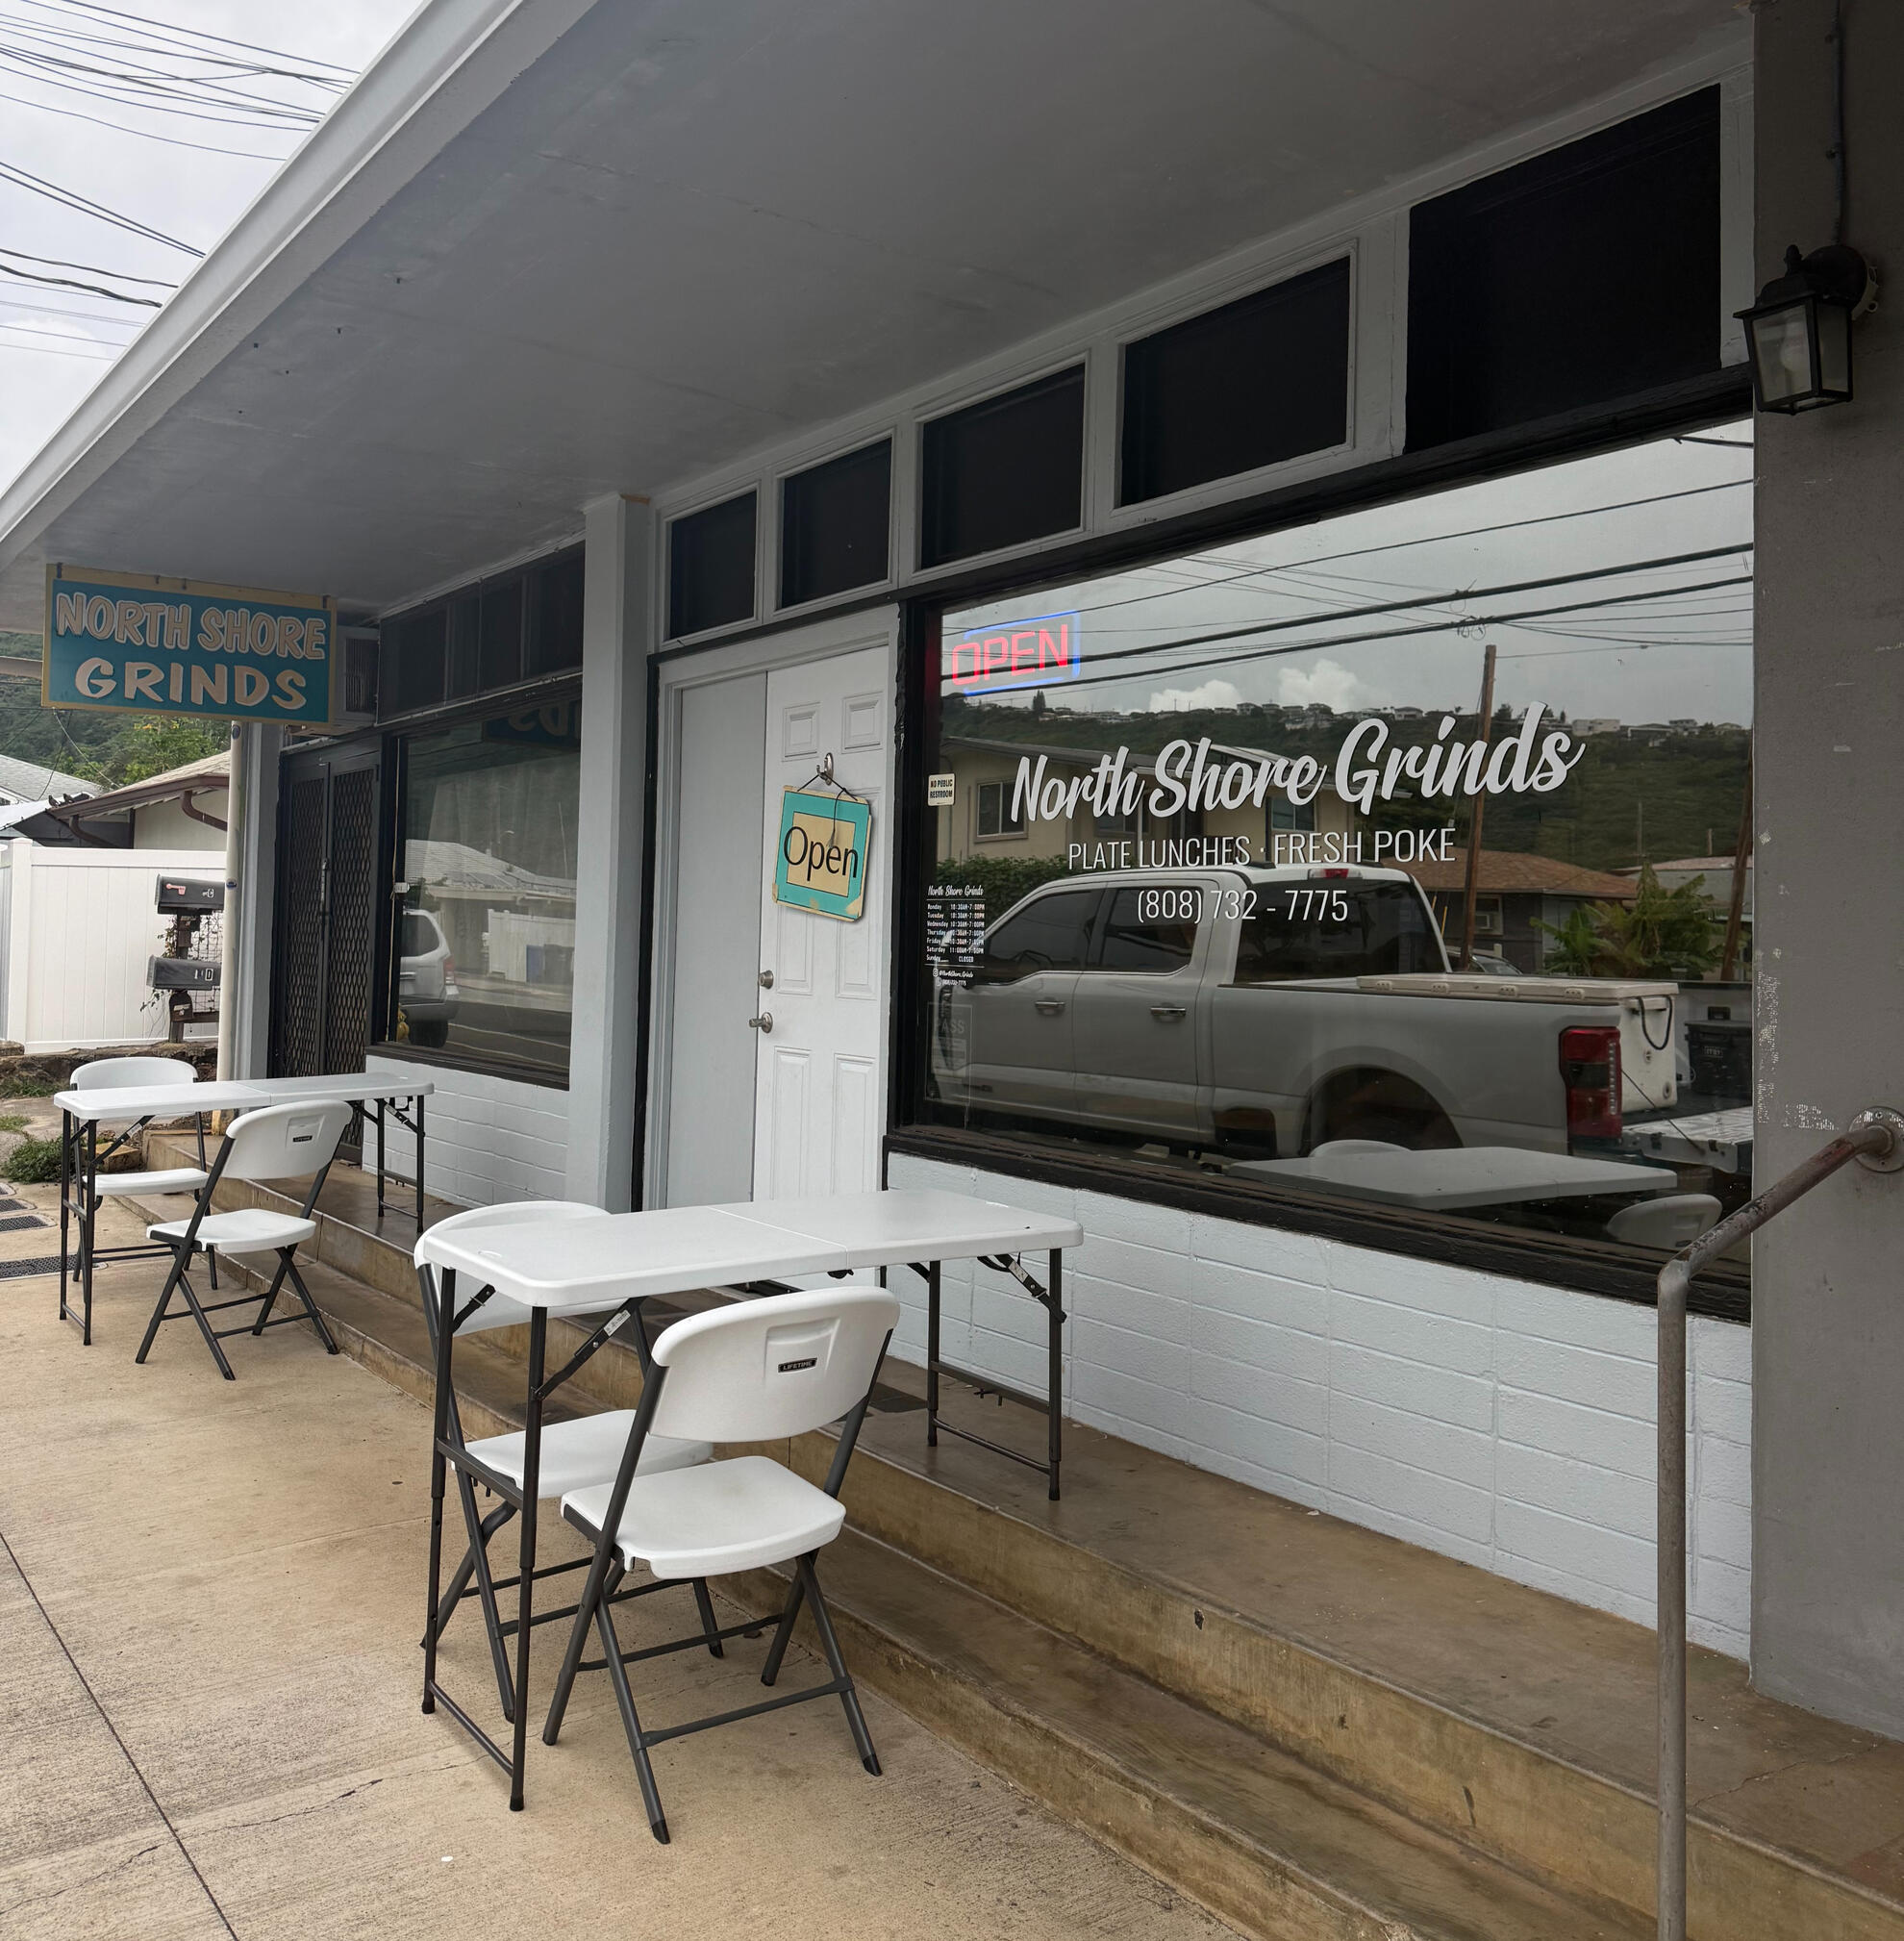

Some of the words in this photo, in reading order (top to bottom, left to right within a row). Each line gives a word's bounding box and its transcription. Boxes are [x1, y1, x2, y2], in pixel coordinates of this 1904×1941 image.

[56, 592, 192, 650] NORTH
[197, 607, 327, 660] SHORE
[951, 623, 1068, 686] OPEN
[75, 657, 307, 710] GRINDS
[1011, 745, 1145, 822] North
[1149, 737, 1326, 817] Shore
[1335, 701, 1586, 816] Grinds
[930, 790, 953, 798] RESTROOM
[938, 779, 953, 788] PUBLIC
[784, 826, 859, 881] Open
[1068, 841, 1131, 870] PLATE
[1139, 836, 1251, 868] LUNCHES
[1274, 831, 1362, 864] FRESH
[1375, 828, 1456, 863] POKE
[928, 885, 943, 895] North
[945, 885, 963, 896] Shore
[965, 885, 984, 896] Grinds
[1138, 890, 1202, 923] (808)
[1211, 890, 1258, 920] 732
[1285, 890, 1348, 921] 7775
[783, 1361, 813, 1371] LIFETIME
